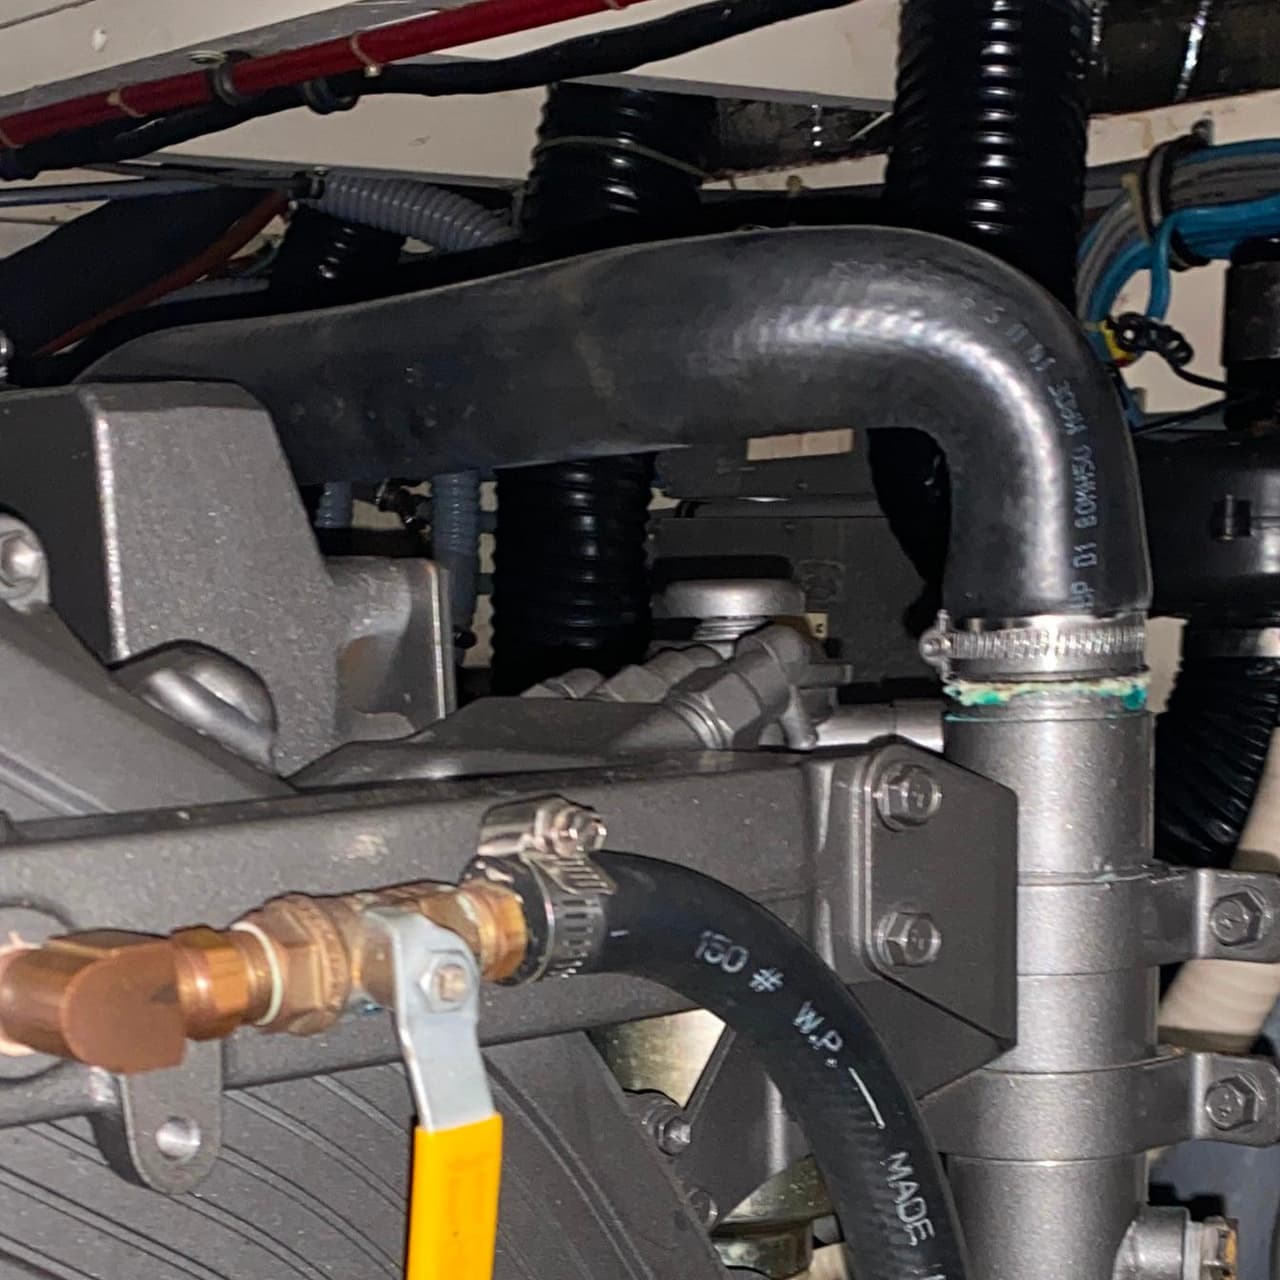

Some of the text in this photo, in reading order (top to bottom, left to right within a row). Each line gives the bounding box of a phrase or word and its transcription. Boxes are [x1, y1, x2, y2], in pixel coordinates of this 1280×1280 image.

[694, 930, 750, 973] 150
[749, 968, 785, 992] #
[792, 1000, 843, 1068] W.P.
[880, 1151, 936, 1246] MADE
